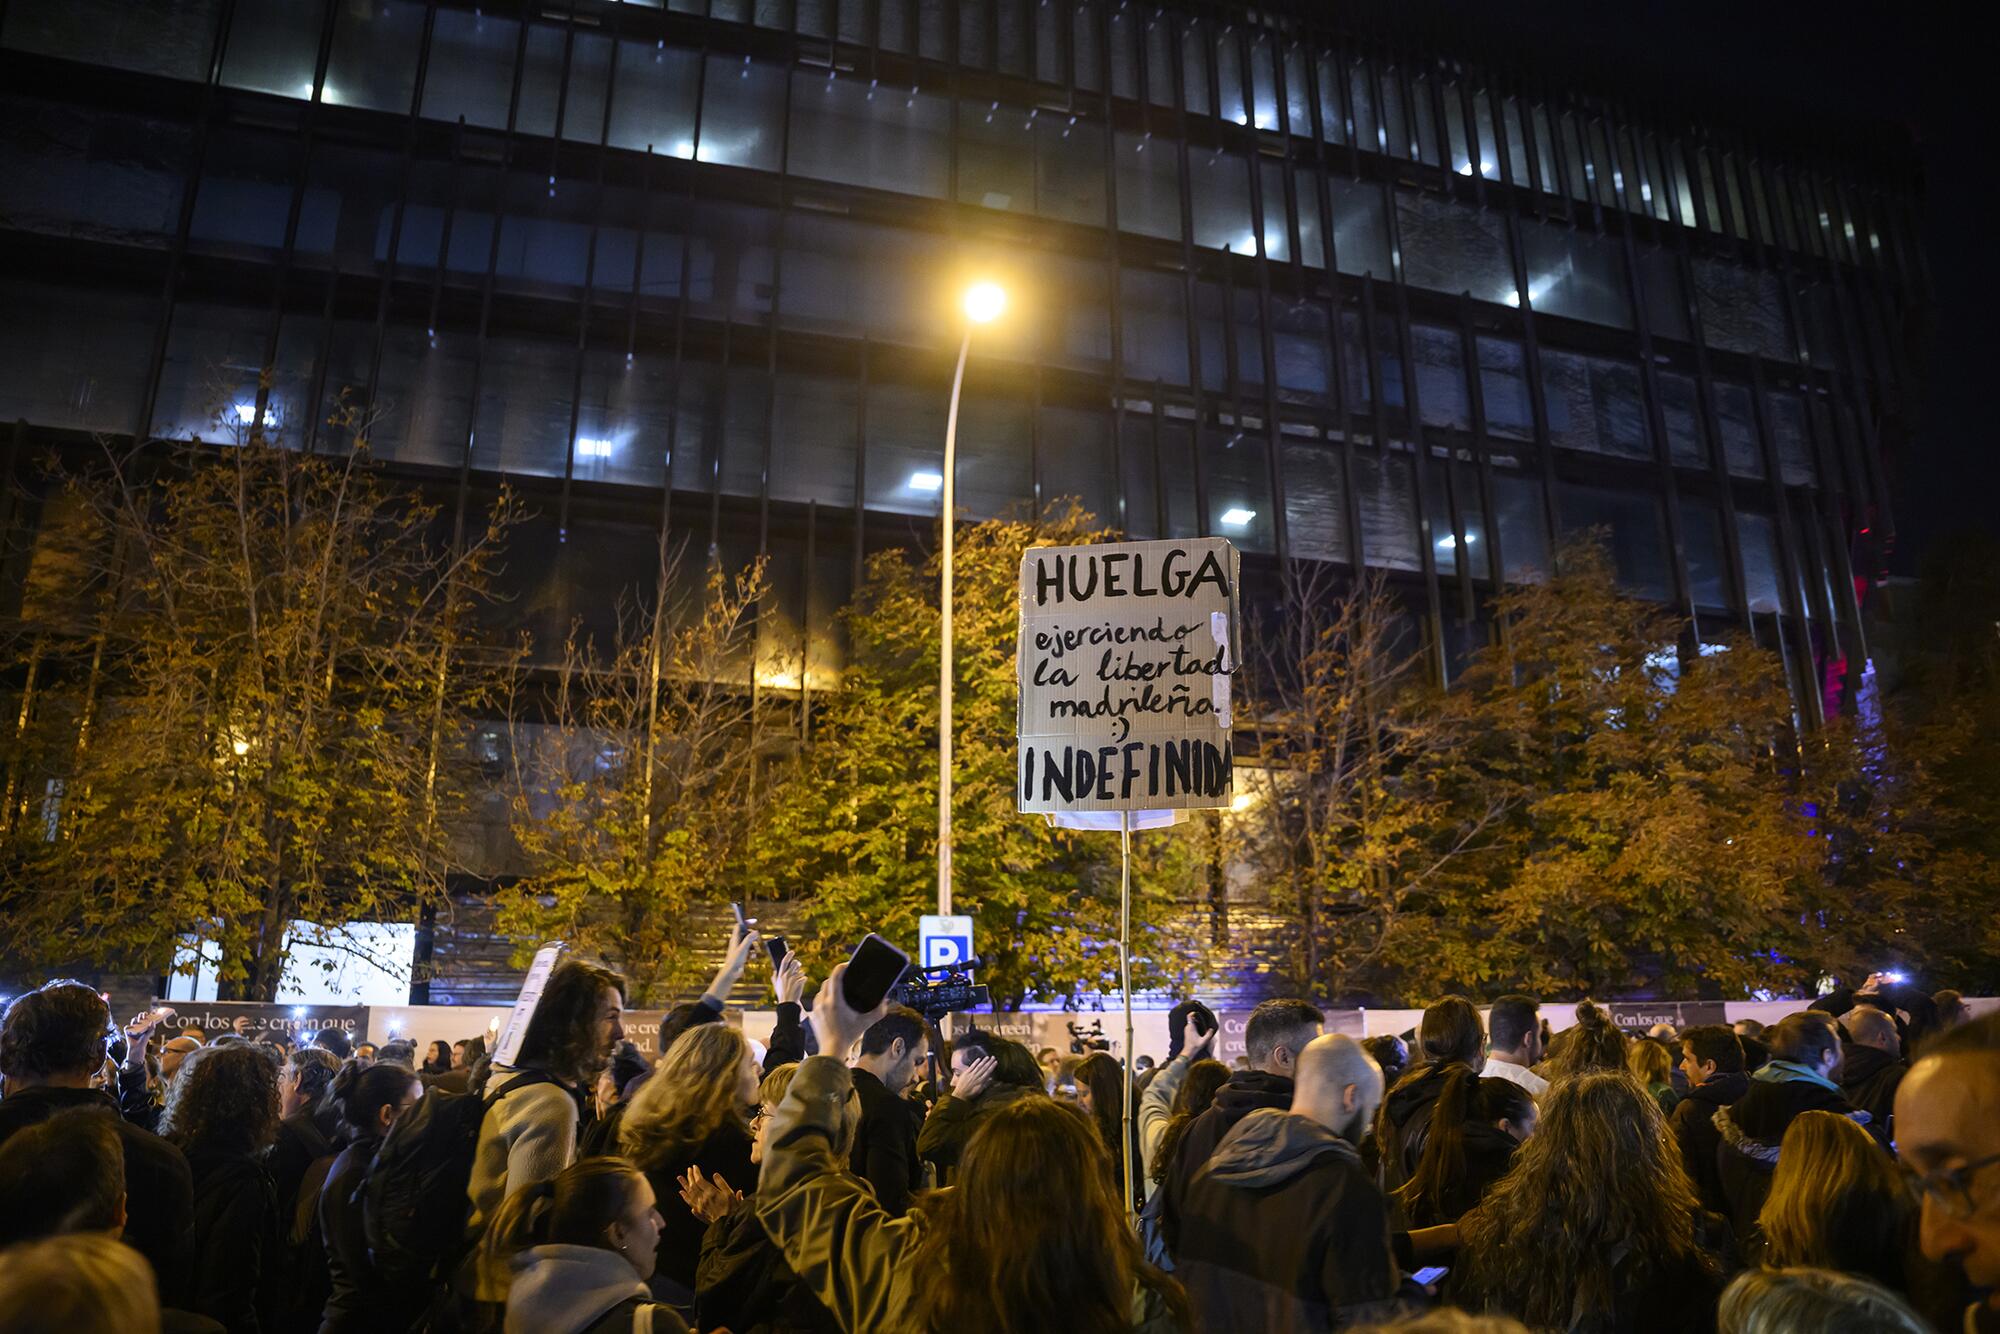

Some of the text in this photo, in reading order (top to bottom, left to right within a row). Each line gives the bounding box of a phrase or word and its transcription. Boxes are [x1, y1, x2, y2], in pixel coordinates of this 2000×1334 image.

[1036, 549, 1230, 606] HUELGA
[1035, 616, 1205, 658] ejerciendo
[1033, 644, 1234, 687] la libertad
[930, 938, 959, 977] P
[204, 1011, 230, 1030] los
[1614, 1013, 1637, 1027] Con
[1637, 1012, 1654, 1027] los
